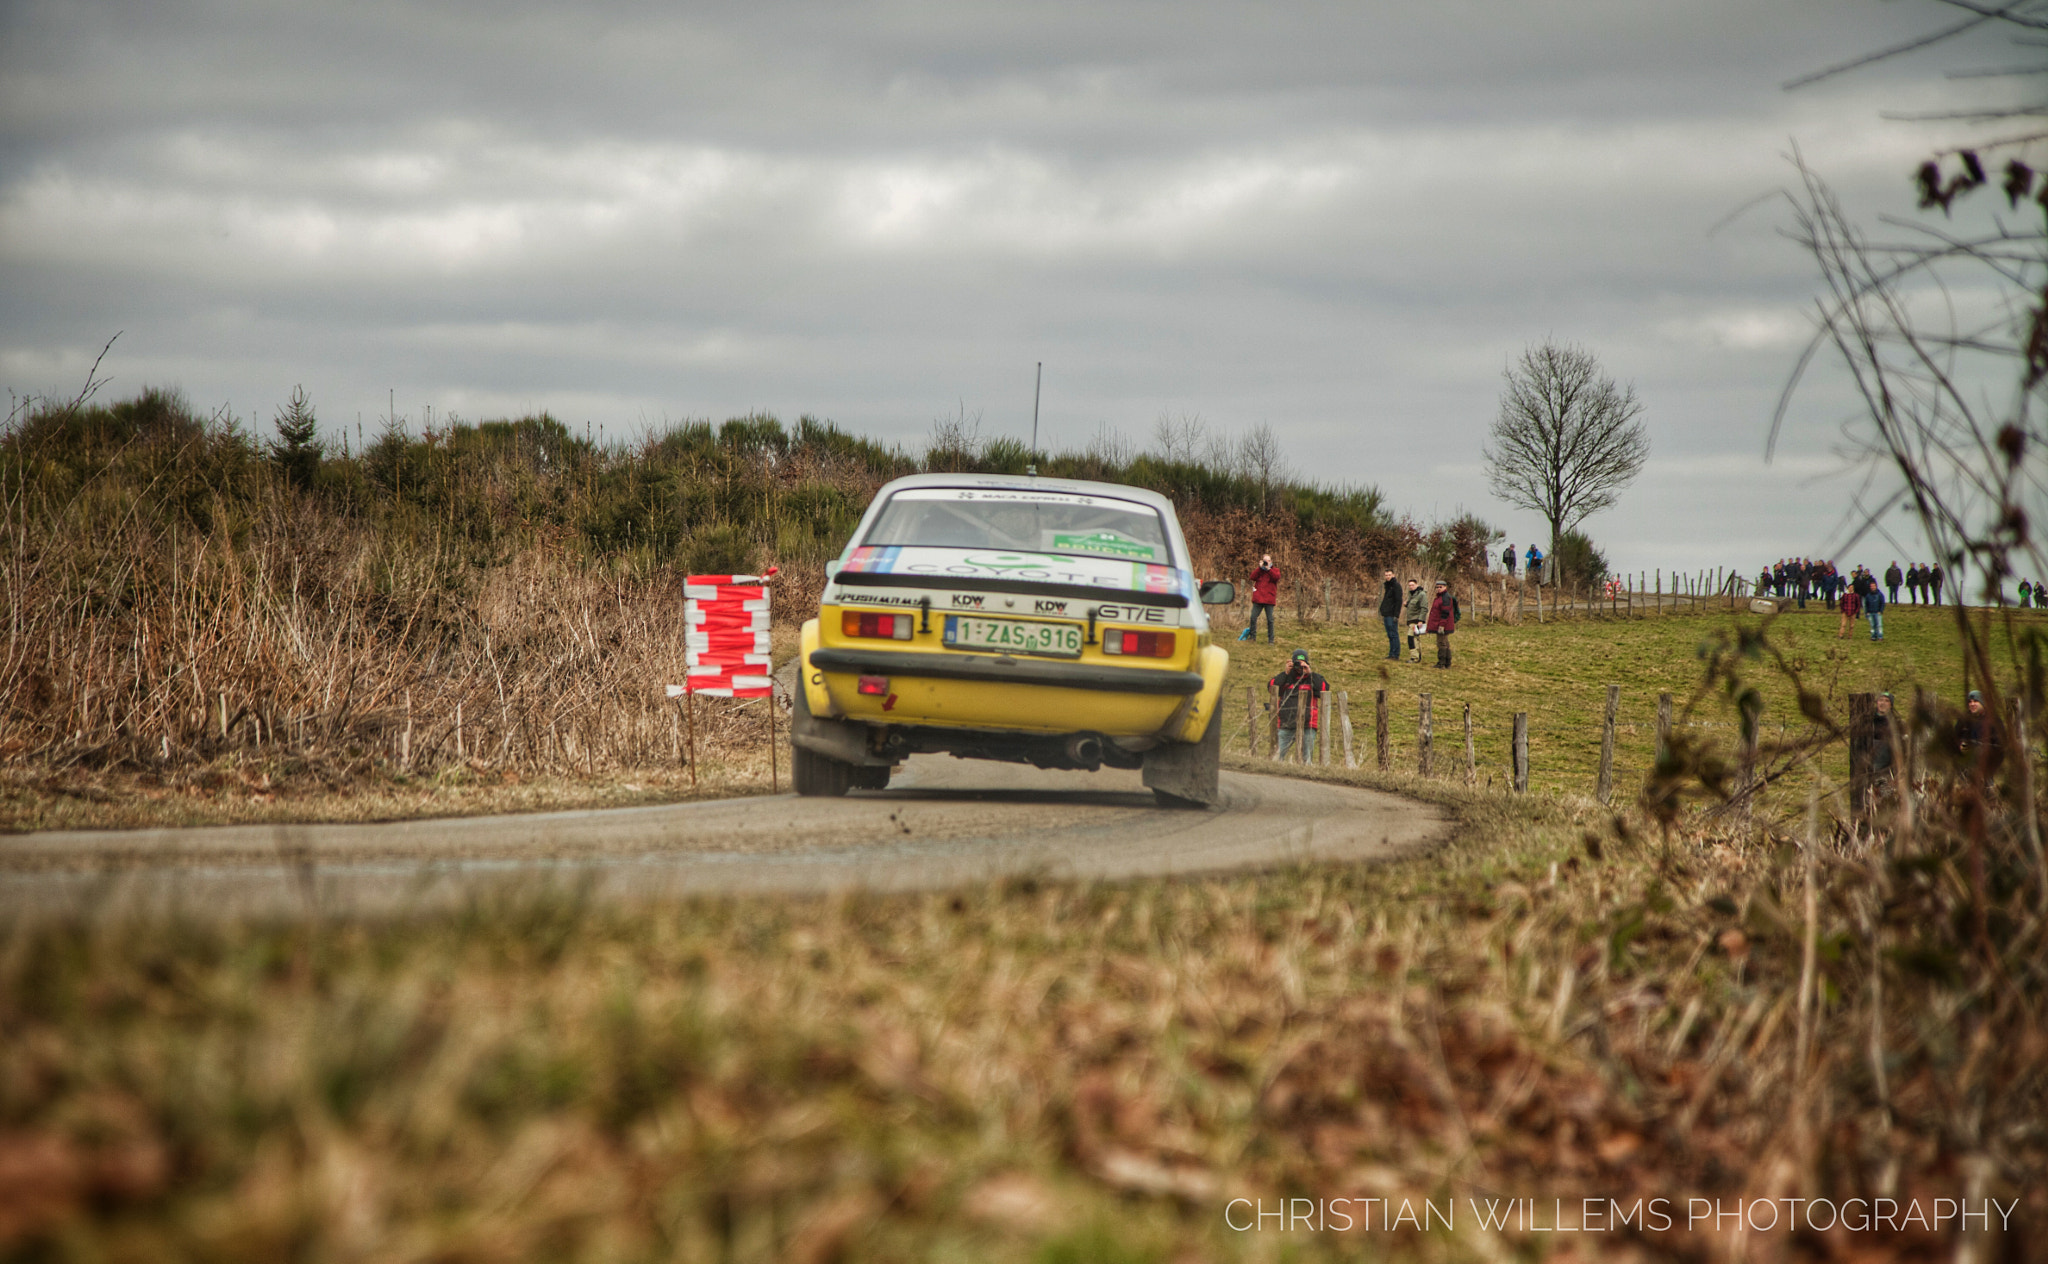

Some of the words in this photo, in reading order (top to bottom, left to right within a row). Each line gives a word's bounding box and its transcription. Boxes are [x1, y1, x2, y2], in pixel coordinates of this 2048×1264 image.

[907, 564, 1119, 587] COYOTE
[952, 594, 985, 605] KDW
[1034, 600, 1067, 611] KDW
[1098, 604, 1165, 622] GT/E
